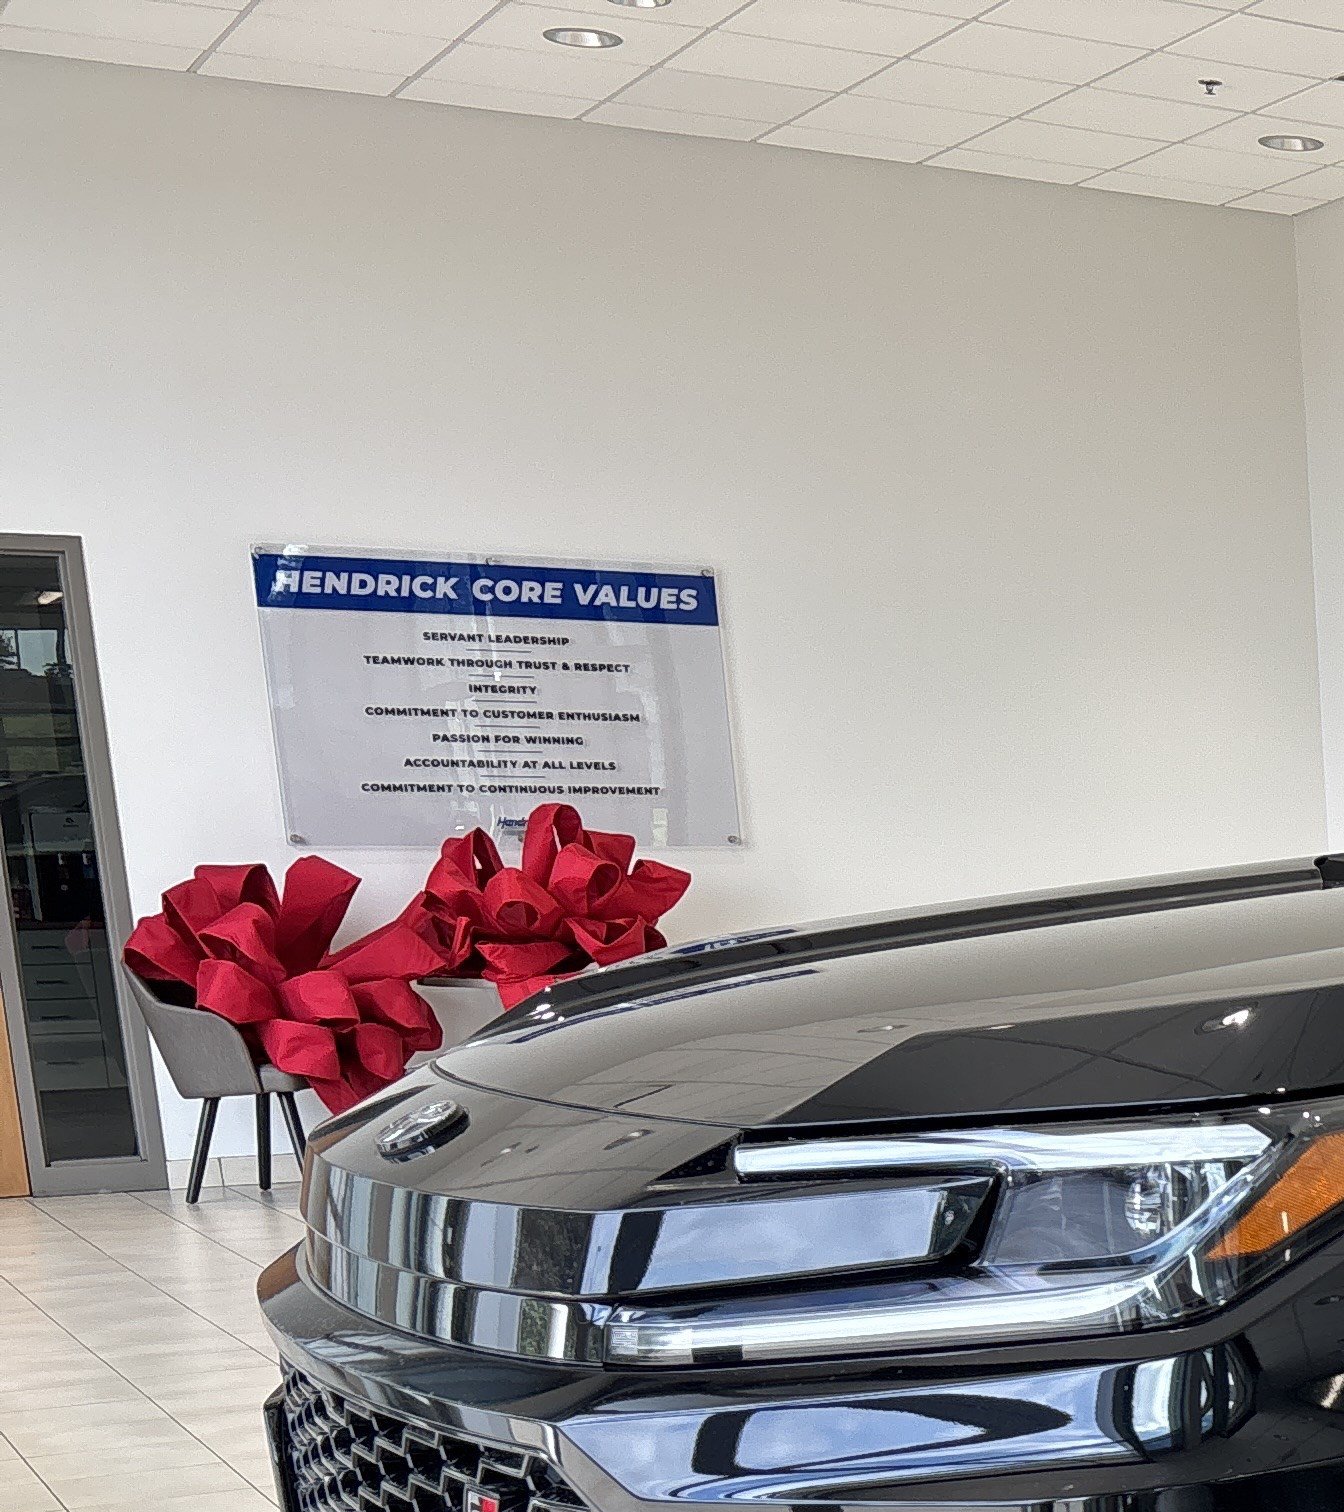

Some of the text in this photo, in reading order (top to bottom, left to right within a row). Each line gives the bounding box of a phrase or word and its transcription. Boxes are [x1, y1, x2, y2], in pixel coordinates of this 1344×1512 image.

[275, 569, 698, 611] HENDRICK CORE VALUES
[422, 631, 570, 646] SERVANT LEADERSHIP
[363, 655, 631, 674] TEAMWORK THROUGH TRUST & RESPECT
[468, 683, 538, 695] INTEGRITY
[364, 706, 641, 723] COMMITMENT TO CUSTOMER ENTHUSIASM
[431, 733, 584, 746] PASSION FOR WINNING
[403, 758, 617, 771] ACCOUNTABILITY AT ALL LEVELS
[360, 782, 661, 796] COMMITMENT TO CONTINUOUS IMPROVEMENT
